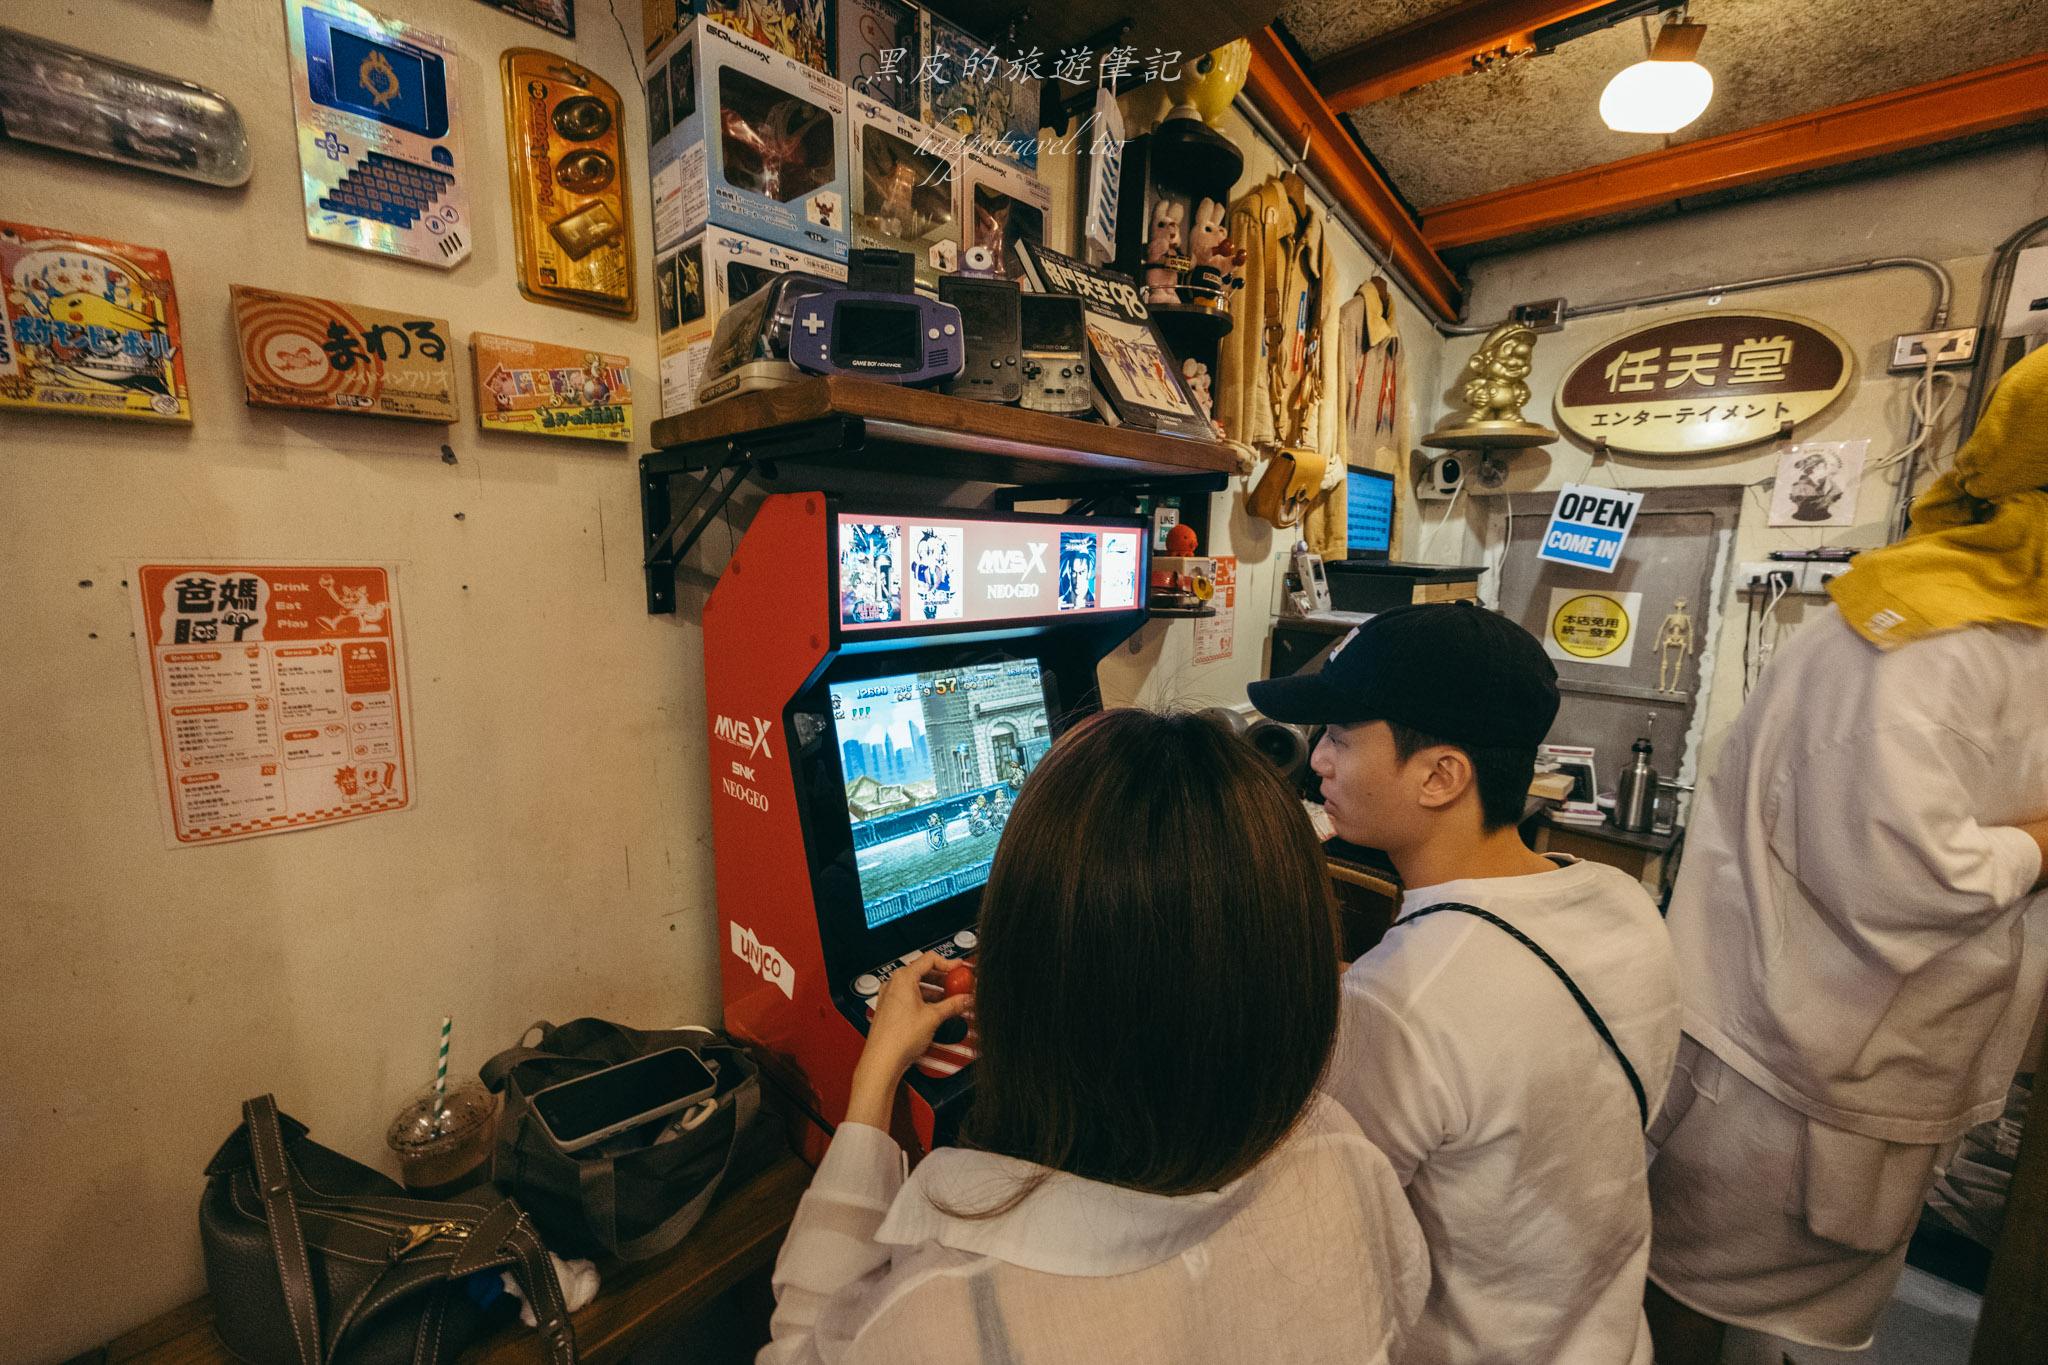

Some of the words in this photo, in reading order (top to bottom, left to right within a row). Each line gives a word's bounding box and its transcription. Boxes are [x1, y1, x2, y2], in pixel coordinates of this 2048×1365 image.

[322, 320, 447, 373] まわる
[852, 359, 867, 367] GAME
[1604, 335, 1795, 394] 任天堂
[1591, 402, 1790, 428] エンターテイメント
[1160, 514, 1174, 525] LINE
[1559, 493, 1634, 529] OPEN
[1548, 530, 1595, 555] COME
[1595, 539, 1619, 560] IN
[175, 578, 258, 613] 爸媽
[273, 582, 310, 592] Drink
[275, 602, 301, 611] Eat
[277, 620, 309, 629] Play
[1560, 626, 1618, 639] 統一發票
[934, 677, 957, 695] 57
[714, 714, 773, 760] MVSX
[731, 761, 756, 782] SNK
[739, 934, 782, 978] UNICO
[876, 962, 897, 975] LEFT
